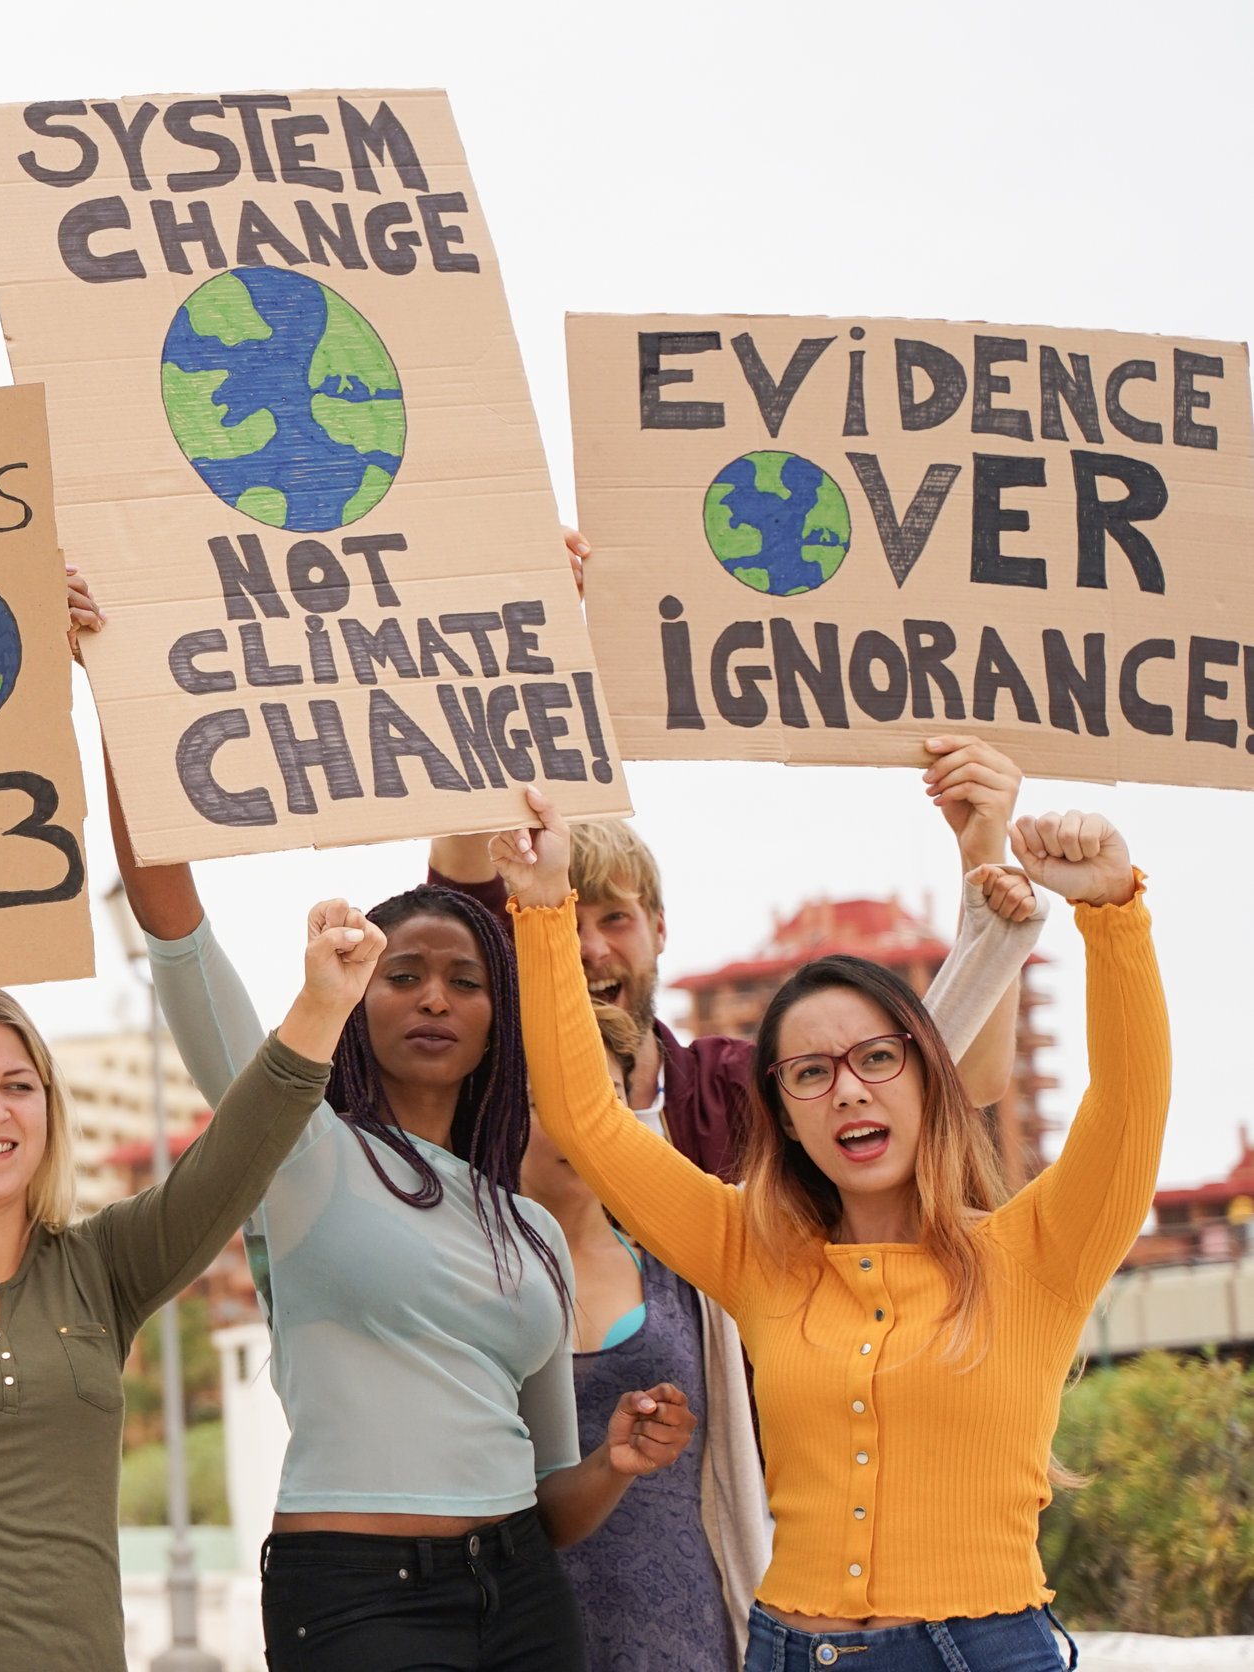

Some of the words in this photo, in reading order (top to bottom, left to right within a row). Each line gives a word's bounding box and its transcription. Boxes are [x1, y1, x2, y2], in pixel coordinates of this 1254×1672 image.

[18, 95, 429, 194] SYSTEM
[57, 192, 480, 283] CHANGE
[207, 534, 408, 621] NOT
[175, 672, 613, 827] CHANGE!
